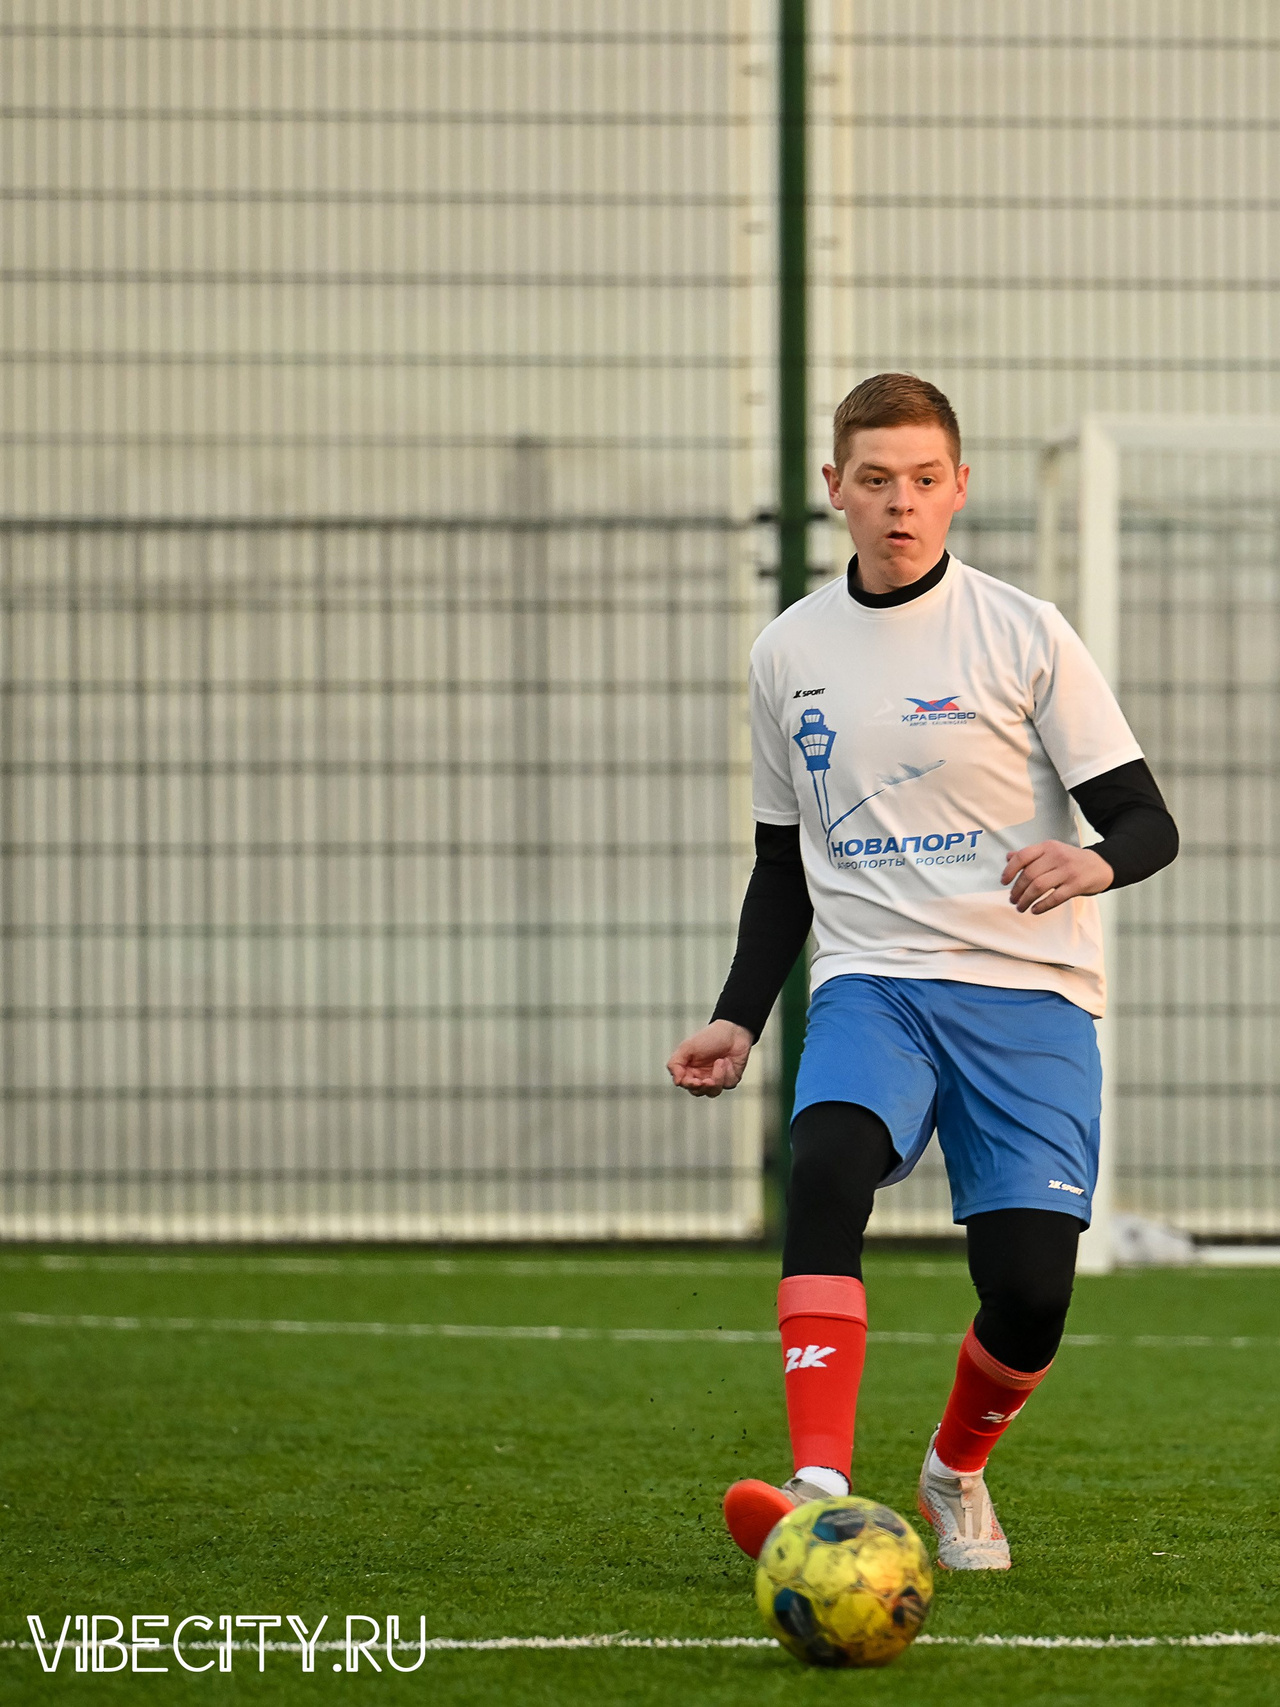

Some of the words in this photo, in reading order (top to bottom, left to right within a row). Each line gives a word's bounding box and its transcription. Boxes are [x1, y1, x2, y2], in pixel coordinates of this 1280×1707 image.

[901, 712, 976, 722] ХРАБРОВО
[831, 830, 983, 857] НОВАПОРТ
[916, 853, 976, 866] РОССИИ
[785, 1345, 837, 1373] 2K
